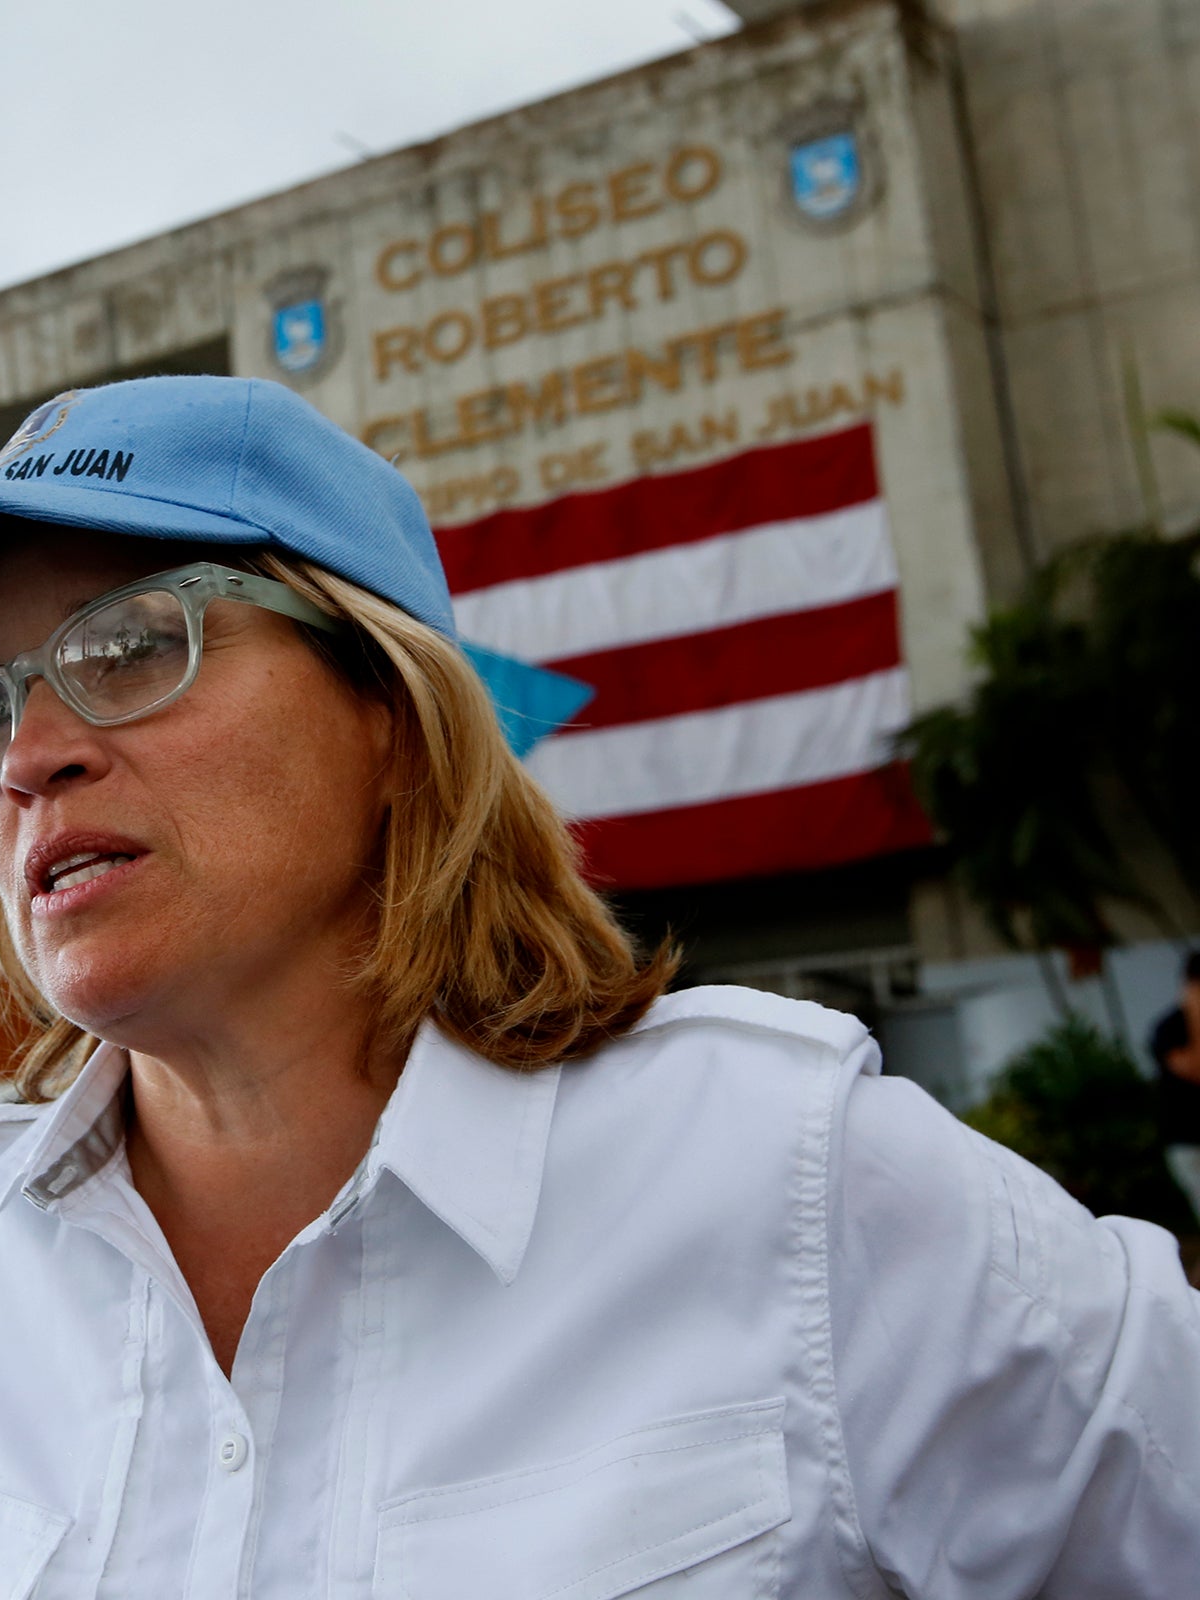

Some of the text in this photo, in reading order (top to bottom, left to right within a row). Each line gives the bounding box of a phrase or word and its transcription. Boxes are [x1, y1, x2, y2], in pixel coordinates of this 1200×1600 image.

[375, 143, 722, 294] COLISEO
[371, 228, 746, 380] ROBERTO
[360, 308, 793, 463] CLEMENTE
[538, 441, 612, 492] DE
[632, 407, 738, 472] SAN
[754, 368, 906, 438] JUAN
[5, 448, 134, 482] SAN JUAN
